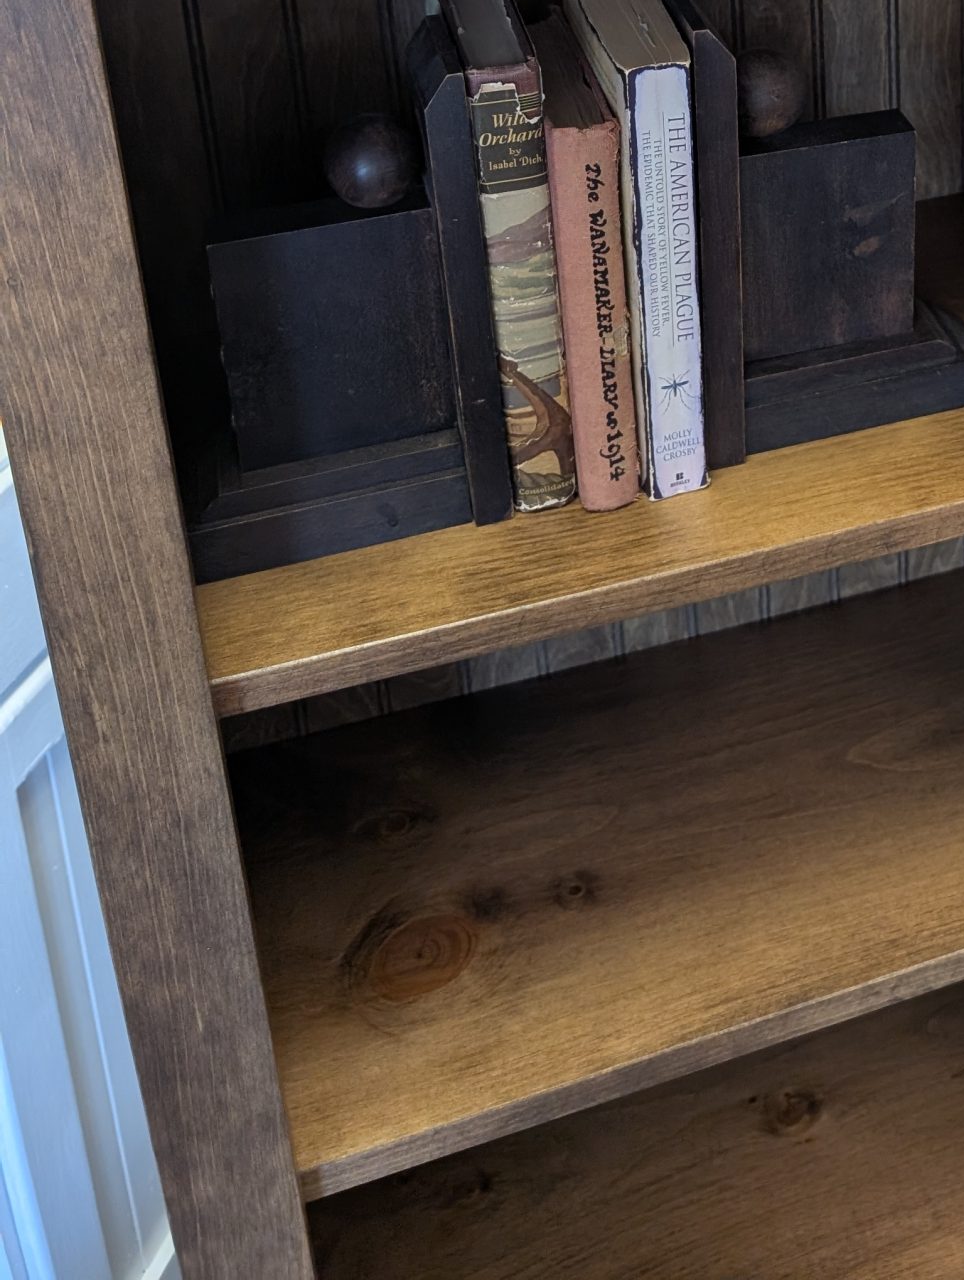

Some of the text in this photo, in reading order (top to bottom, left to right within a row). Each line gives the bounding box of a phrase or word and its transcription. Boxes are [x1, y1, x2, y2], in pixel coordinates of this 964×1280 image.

[479, 123, 543, 147] Orchard
[508, 147, 522, 157] by
[653, 138, 662, 159] THE
[488, 158, 517, 171] Isabel
[655, 160, 664, 203] UNTOLD
[657, 205, 666, 236] STORY
[667, 112, 695, 343] THE AMERICAN PLAGUE
[642, 129, 661, 338] THE EPIDEMIC THAT SHAPED OUR HISTORY
[658, 239, 667, 252] OF
[659, 254, 669, 292] YELLOW
[584, 162, 605, 203] The
[600, 428, 626, 482] 1914
[655, 437, 700, 454] CALDWELL
[663, 428, 692, 442] MOLLY
[663, 447, 697, 462] CROSBY
